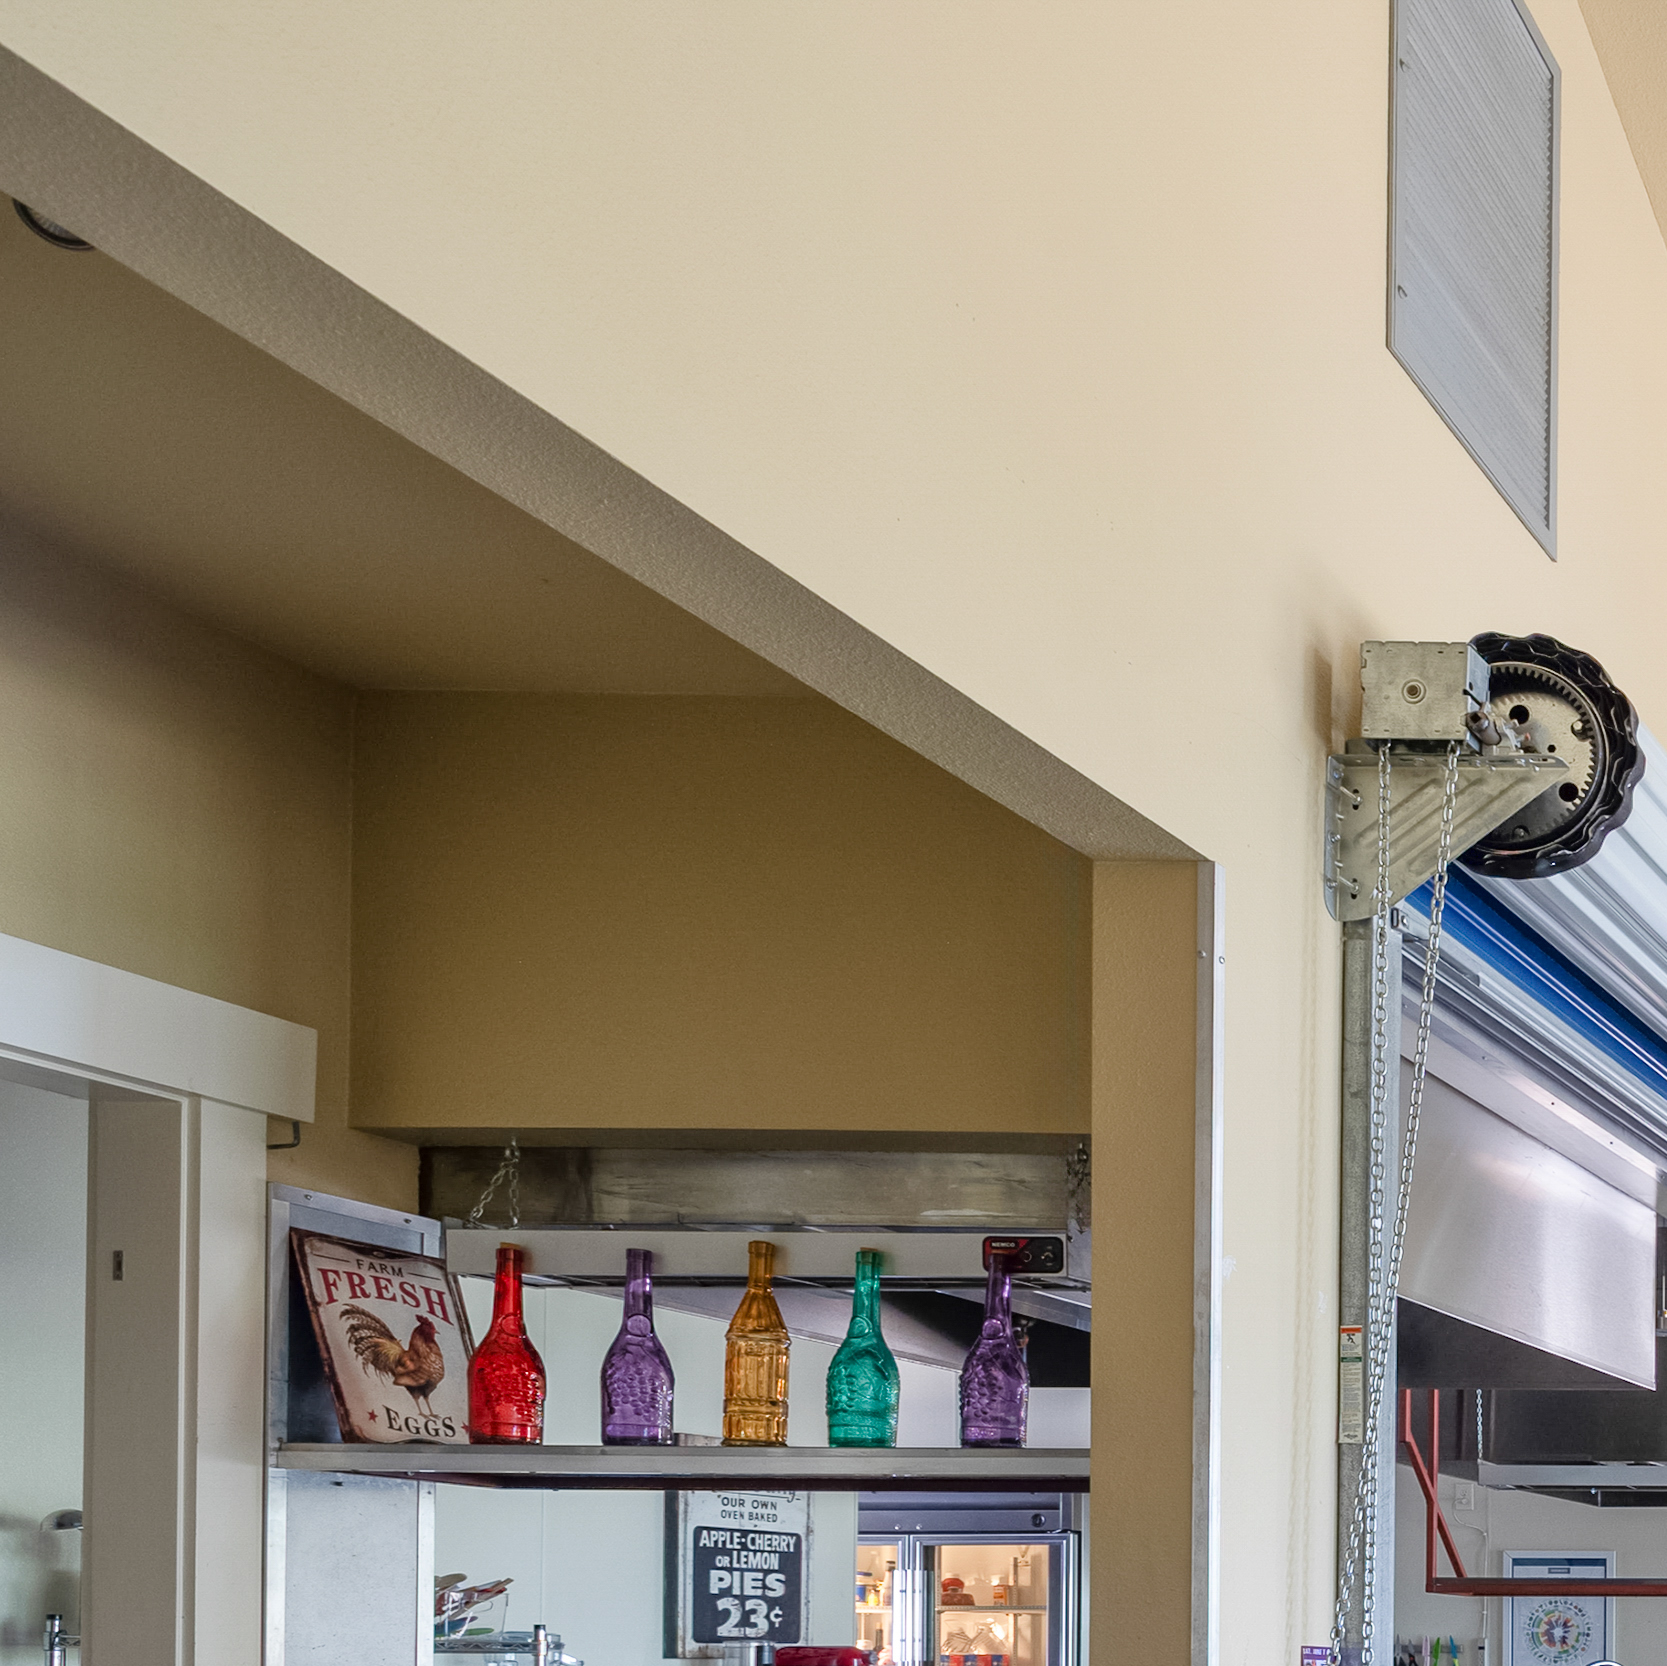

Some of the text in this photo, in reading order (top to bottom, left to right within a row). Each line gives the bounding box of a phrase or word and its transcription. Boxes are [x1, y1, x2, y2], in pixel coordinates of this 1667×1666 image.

[356, 1259, 404, 1278] FARM
[317, 1268, 455, 1326] FRESH
[382, 1404, 456, 1438] EGGS
[721, 1496, 746, 1508] OUR
[751, 1499, 778, 1511] OWN
[720, 1509, 778, 1523] OVEN BAKED
[715, 1551, 780, 1570] OR LEMON
[709, 1569, 786, 1598] PIES
